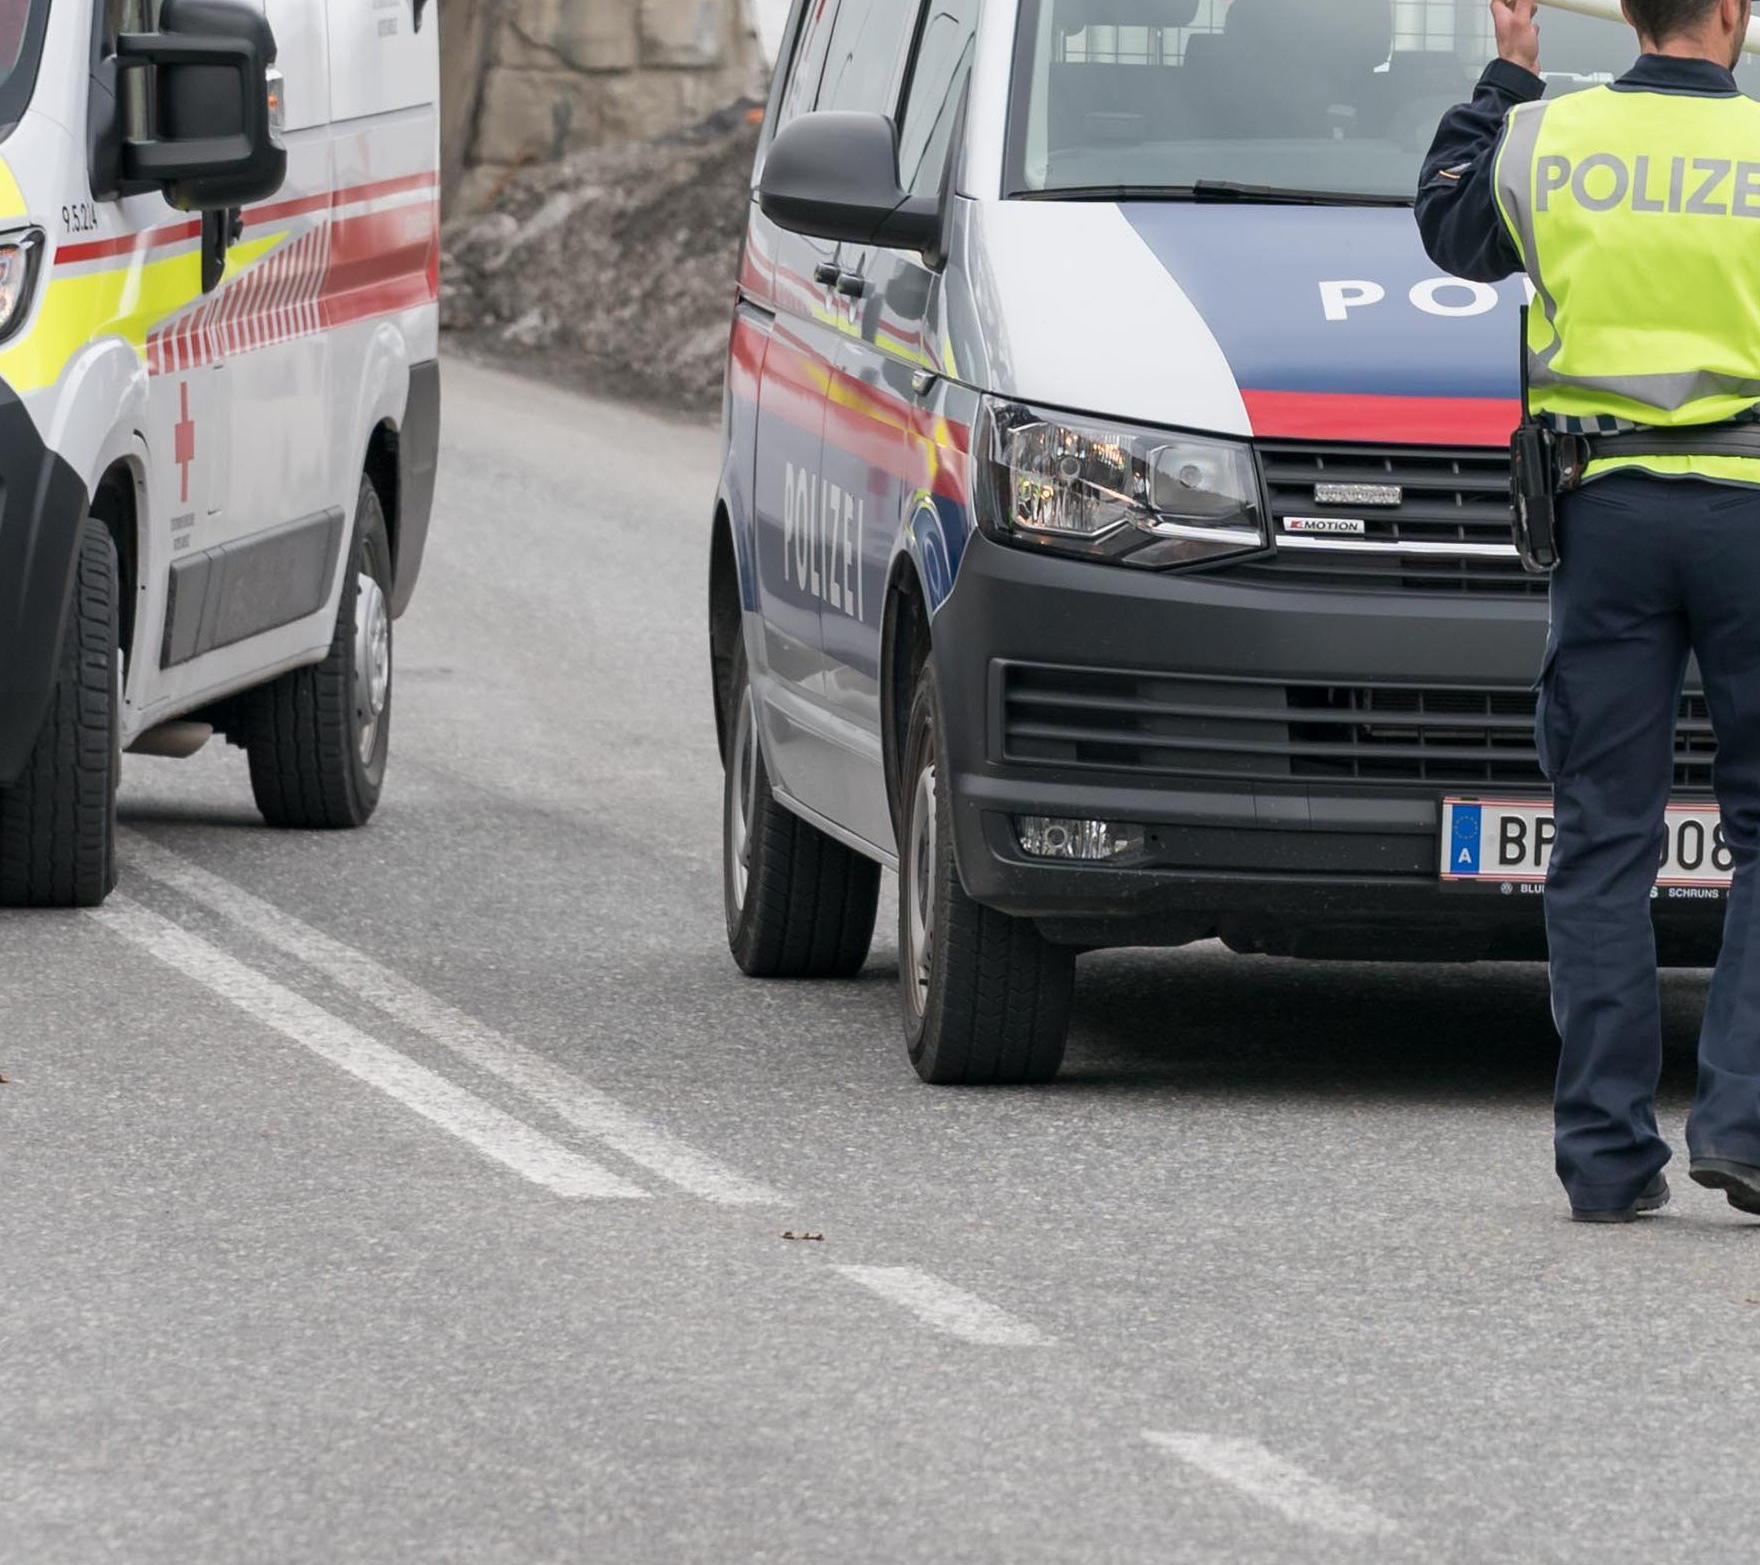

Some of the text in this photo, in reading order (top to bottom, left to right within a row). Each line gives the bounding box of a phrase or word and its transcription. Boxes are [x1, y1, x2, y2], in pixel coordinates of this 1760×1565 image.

[1318, 276, 1532, 321] PO
[784, 461, 864, 623] POLIZEI
[1458, 848, 1472, 864] A
[1668, 887, 1719, 899] SCHRUNS
